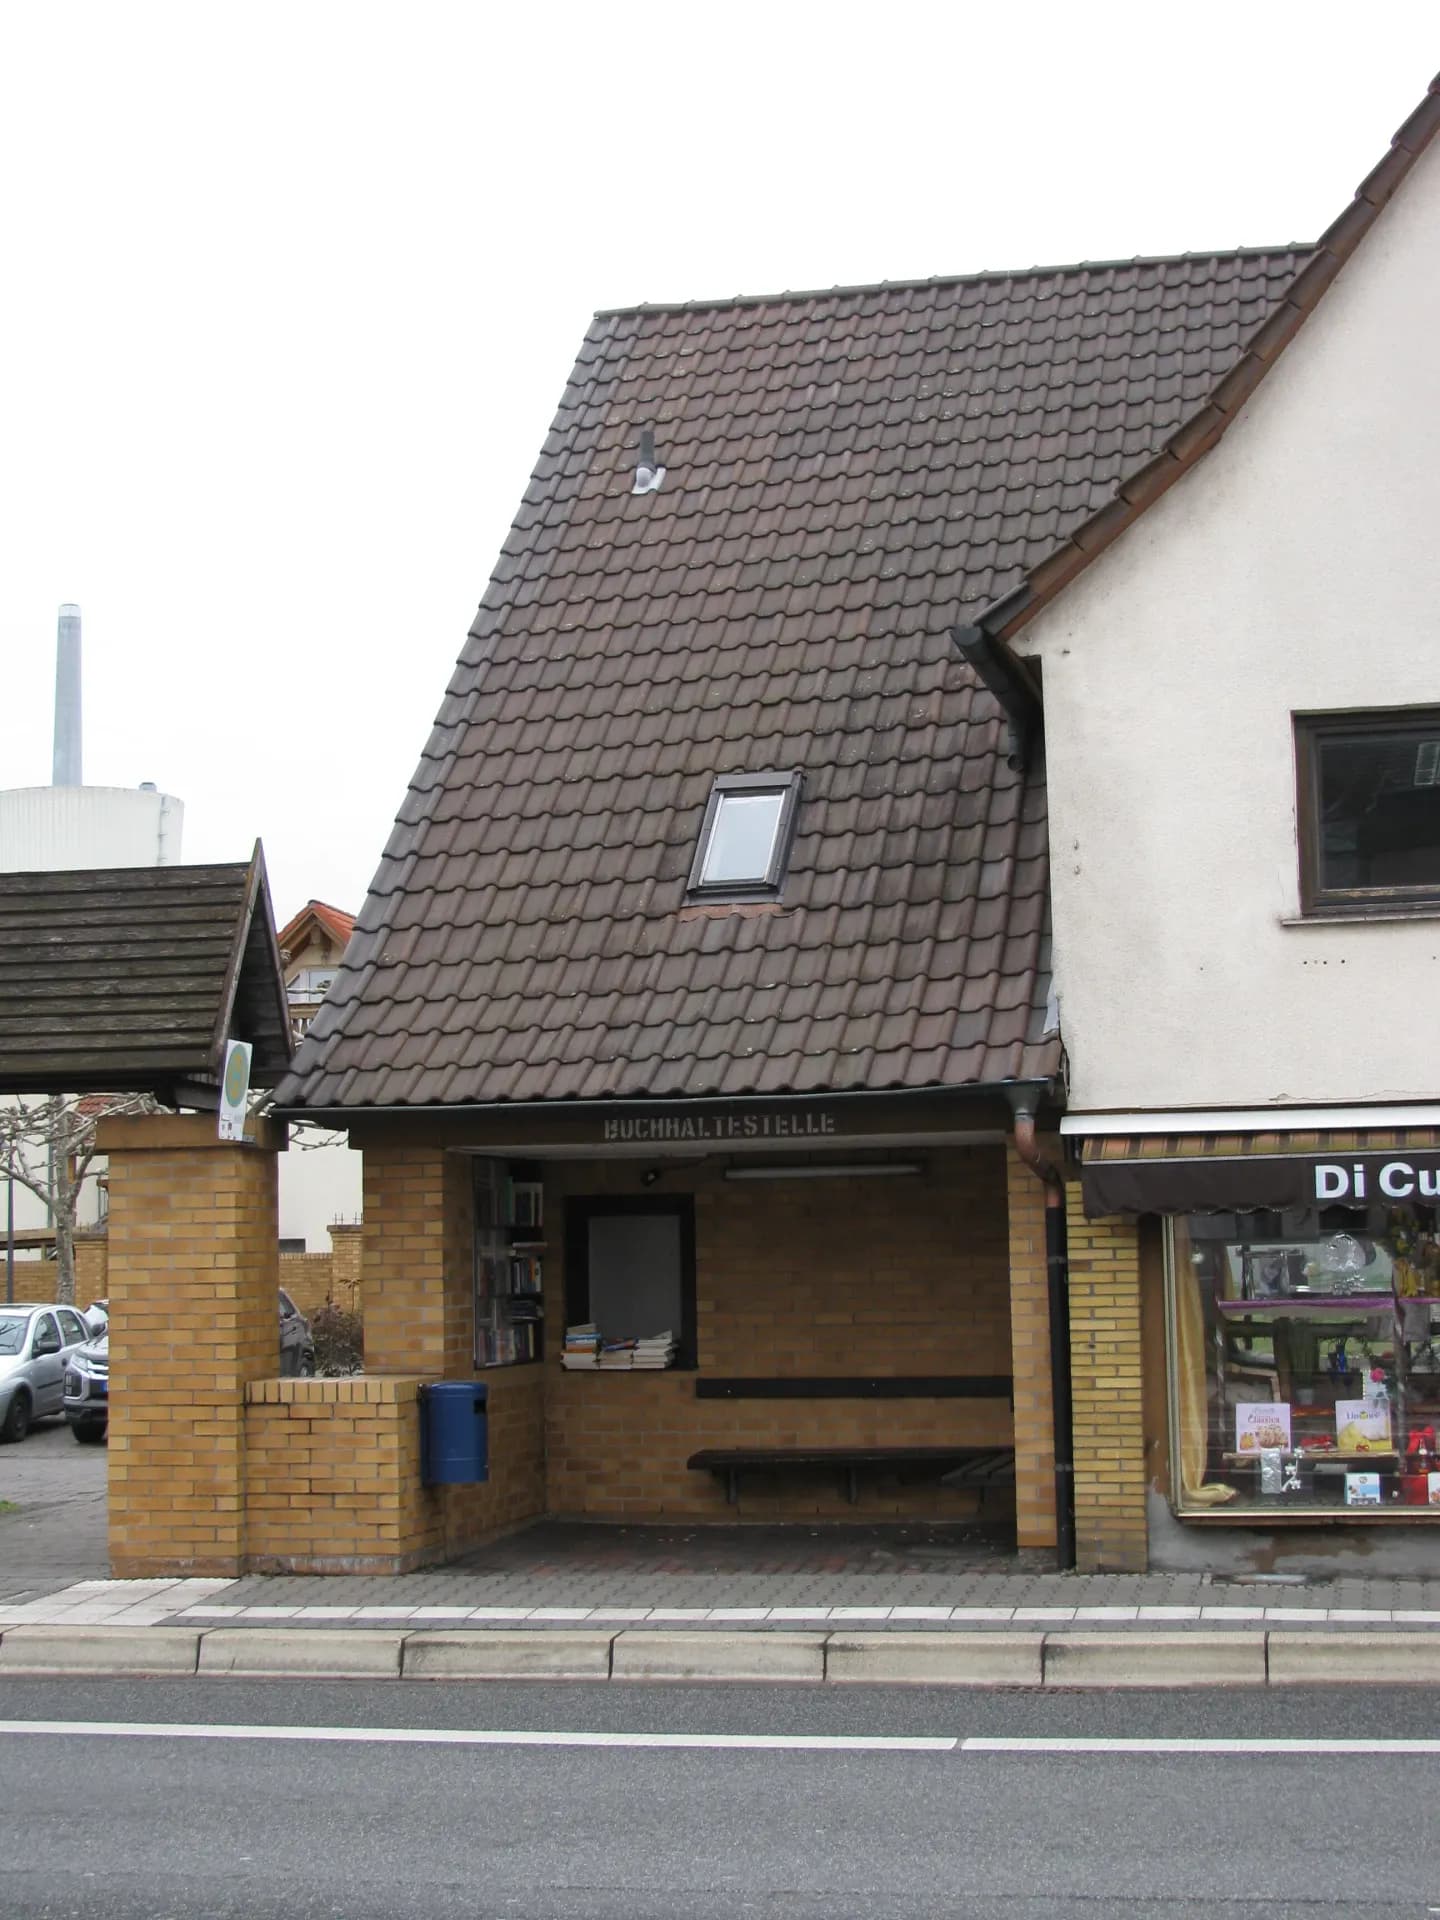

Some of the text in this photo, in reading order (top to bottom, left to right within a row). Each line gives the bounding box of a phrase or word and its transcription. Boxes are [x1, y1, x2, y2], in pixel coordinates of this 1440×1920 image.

[603, 1113, 836, 1139] BUCHHALTESTELLE
[1315, 1162, 1440, 1198] Di Cu
